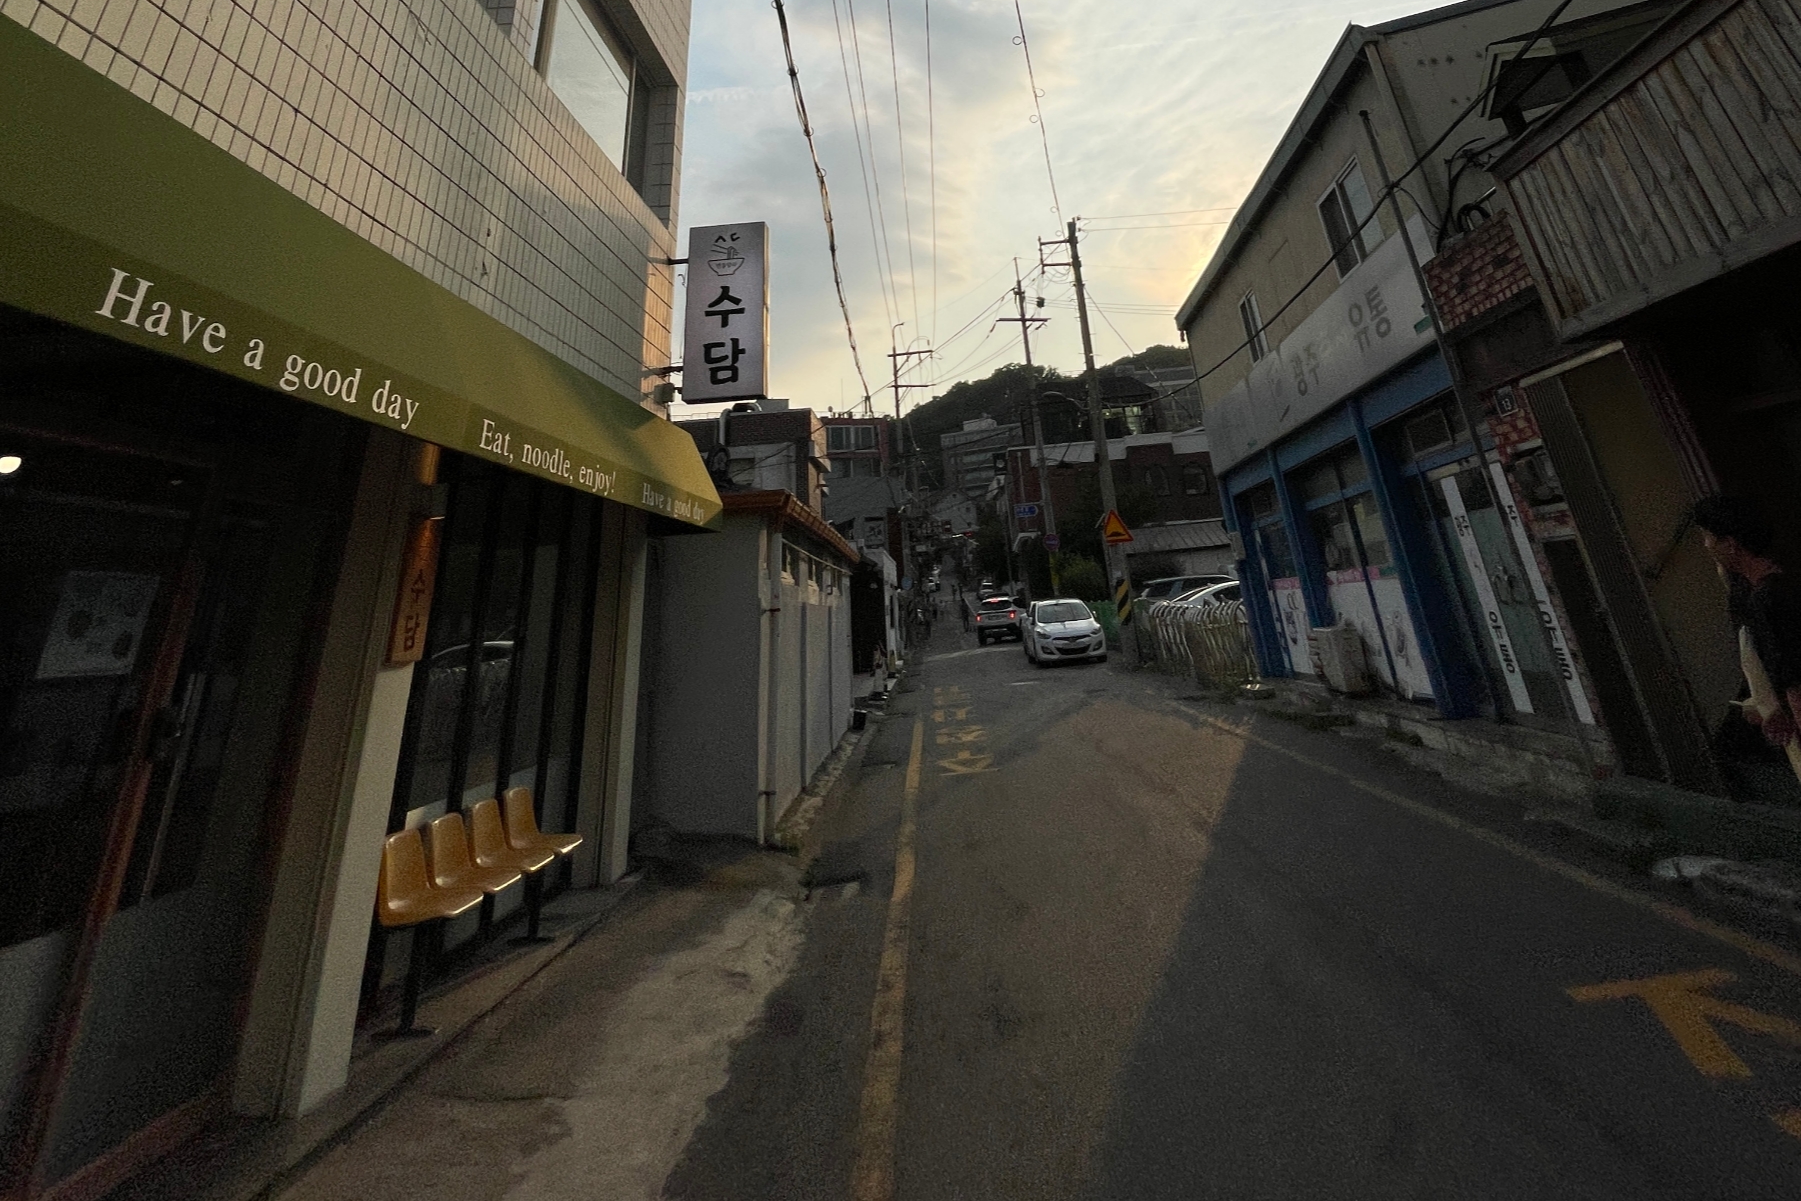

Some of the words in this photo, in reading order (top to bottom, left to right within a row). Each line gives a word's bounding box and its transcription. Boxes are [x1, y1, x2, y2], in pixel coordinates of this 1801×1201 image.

[95, 267, 227, 353] Have
[243, 339, 265, 370] a
[279, 354, 362, 403] good
[372, 380, 419, 430] day
[703, 285, 747, 385] 수담
[479, 418, 514, 464] Eat,
[521, 443, 574, 484] noodle,
[579, 464, 616, 496] enjoy!
[641, 482, 665, 509] Have
[666, 497, 672, 512] a
[673, 499, 692, 518] good
[403, 568, 427, 653] 수담
